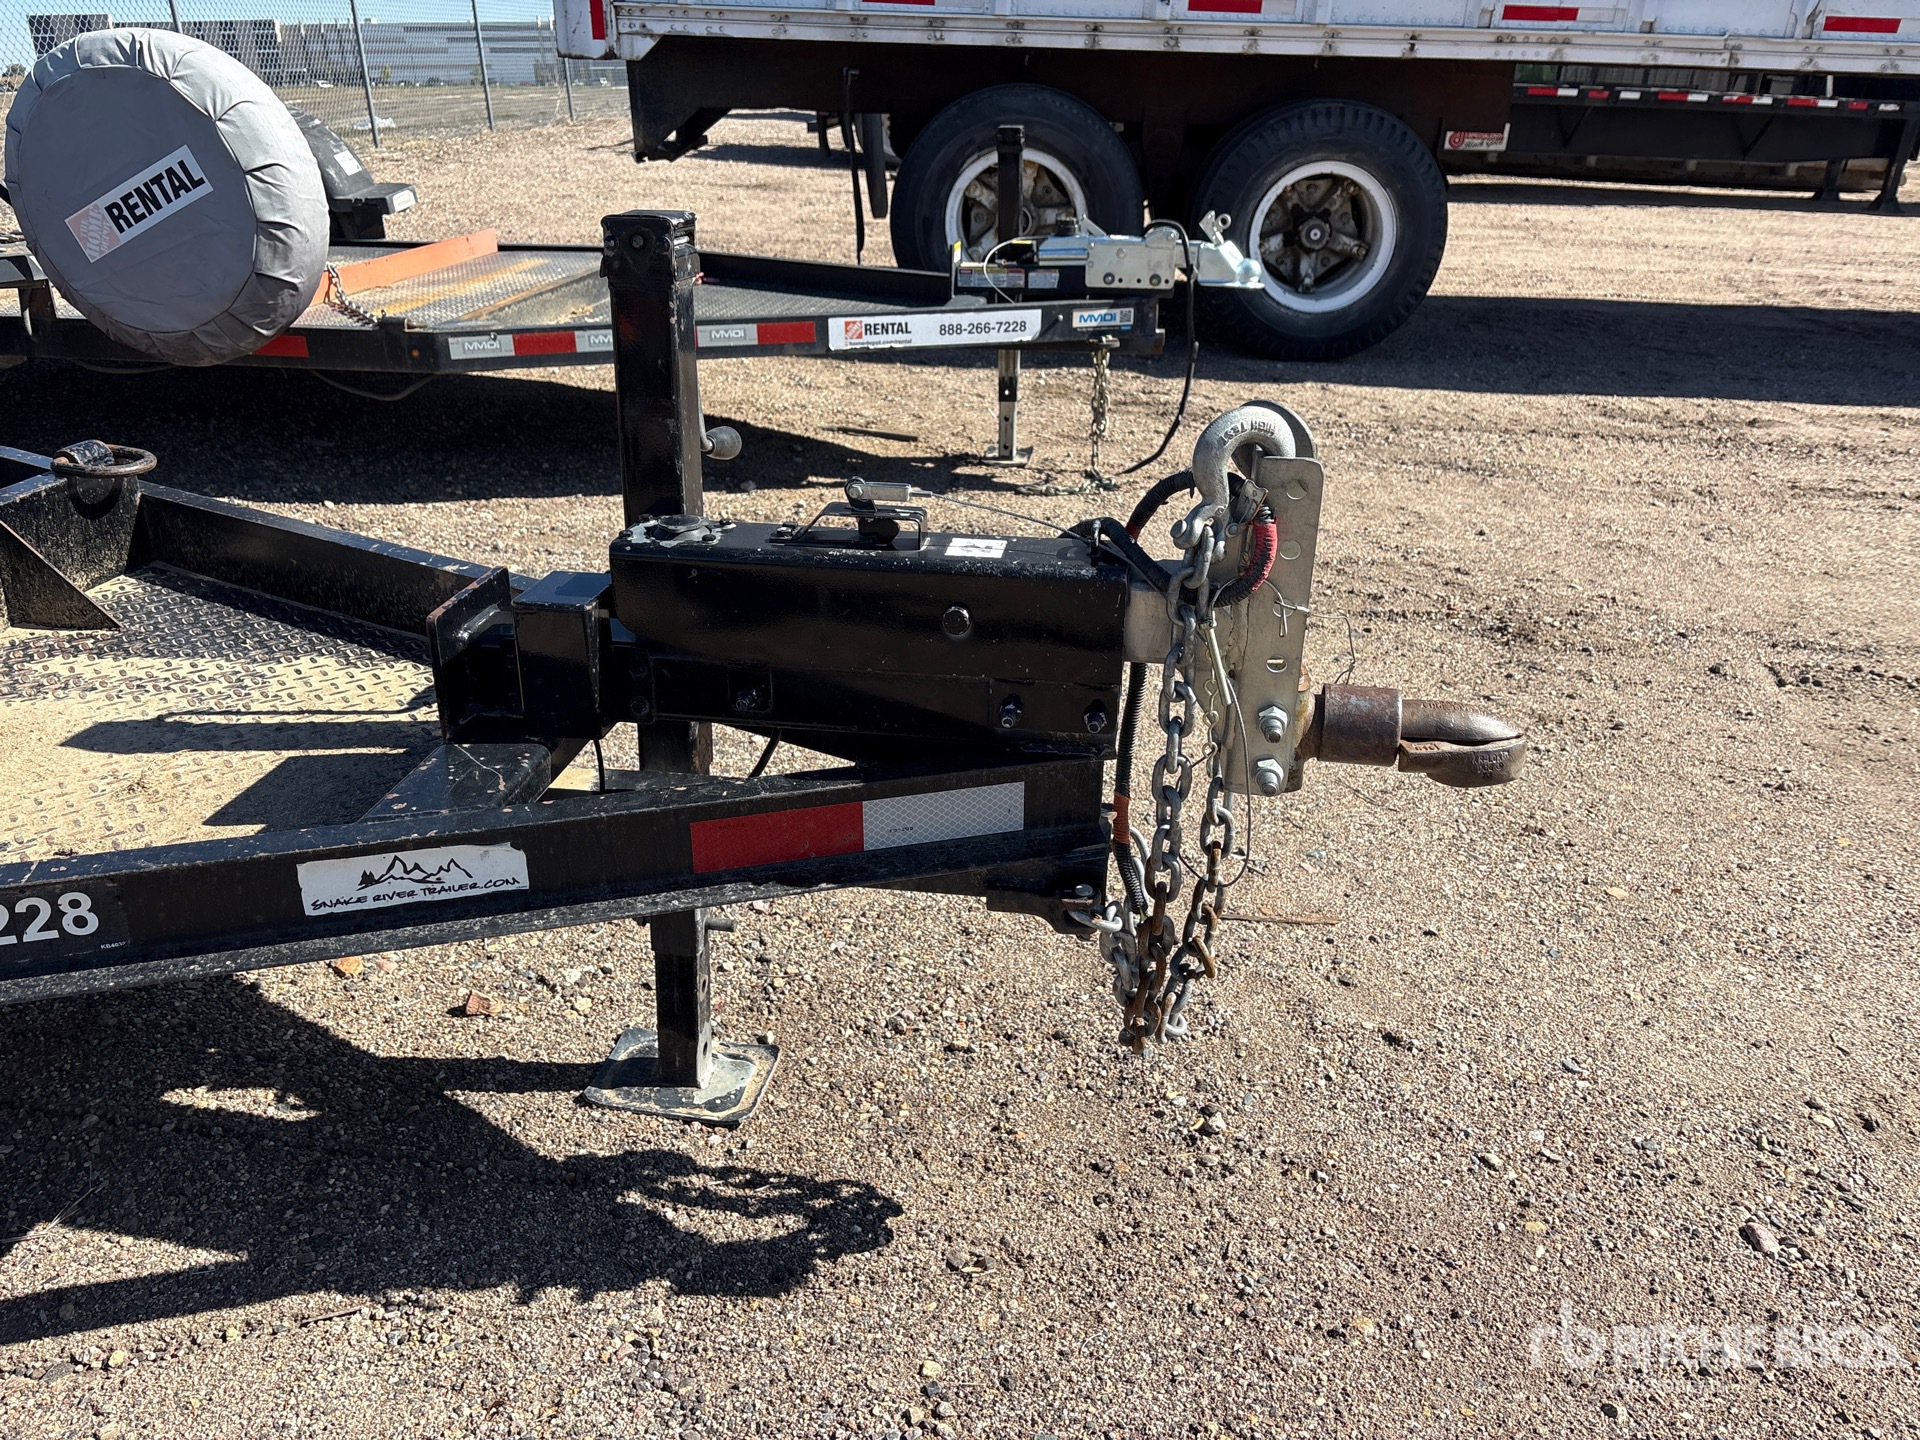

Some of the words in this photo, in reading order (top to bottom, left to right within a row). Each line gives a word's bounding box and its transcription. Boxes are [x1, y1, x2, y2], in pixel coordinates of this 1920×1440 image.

[104, 159, 206, 234] RENTAL
[864, 322, 912, 336] RENTAL
[939, 320, 1027, 336] 888-266-7228
[311, 896, 368, 911] SNAKE
[373, 890, 418, 902] RIVER
[420, 877, 520, 896] TRAILER.COM
